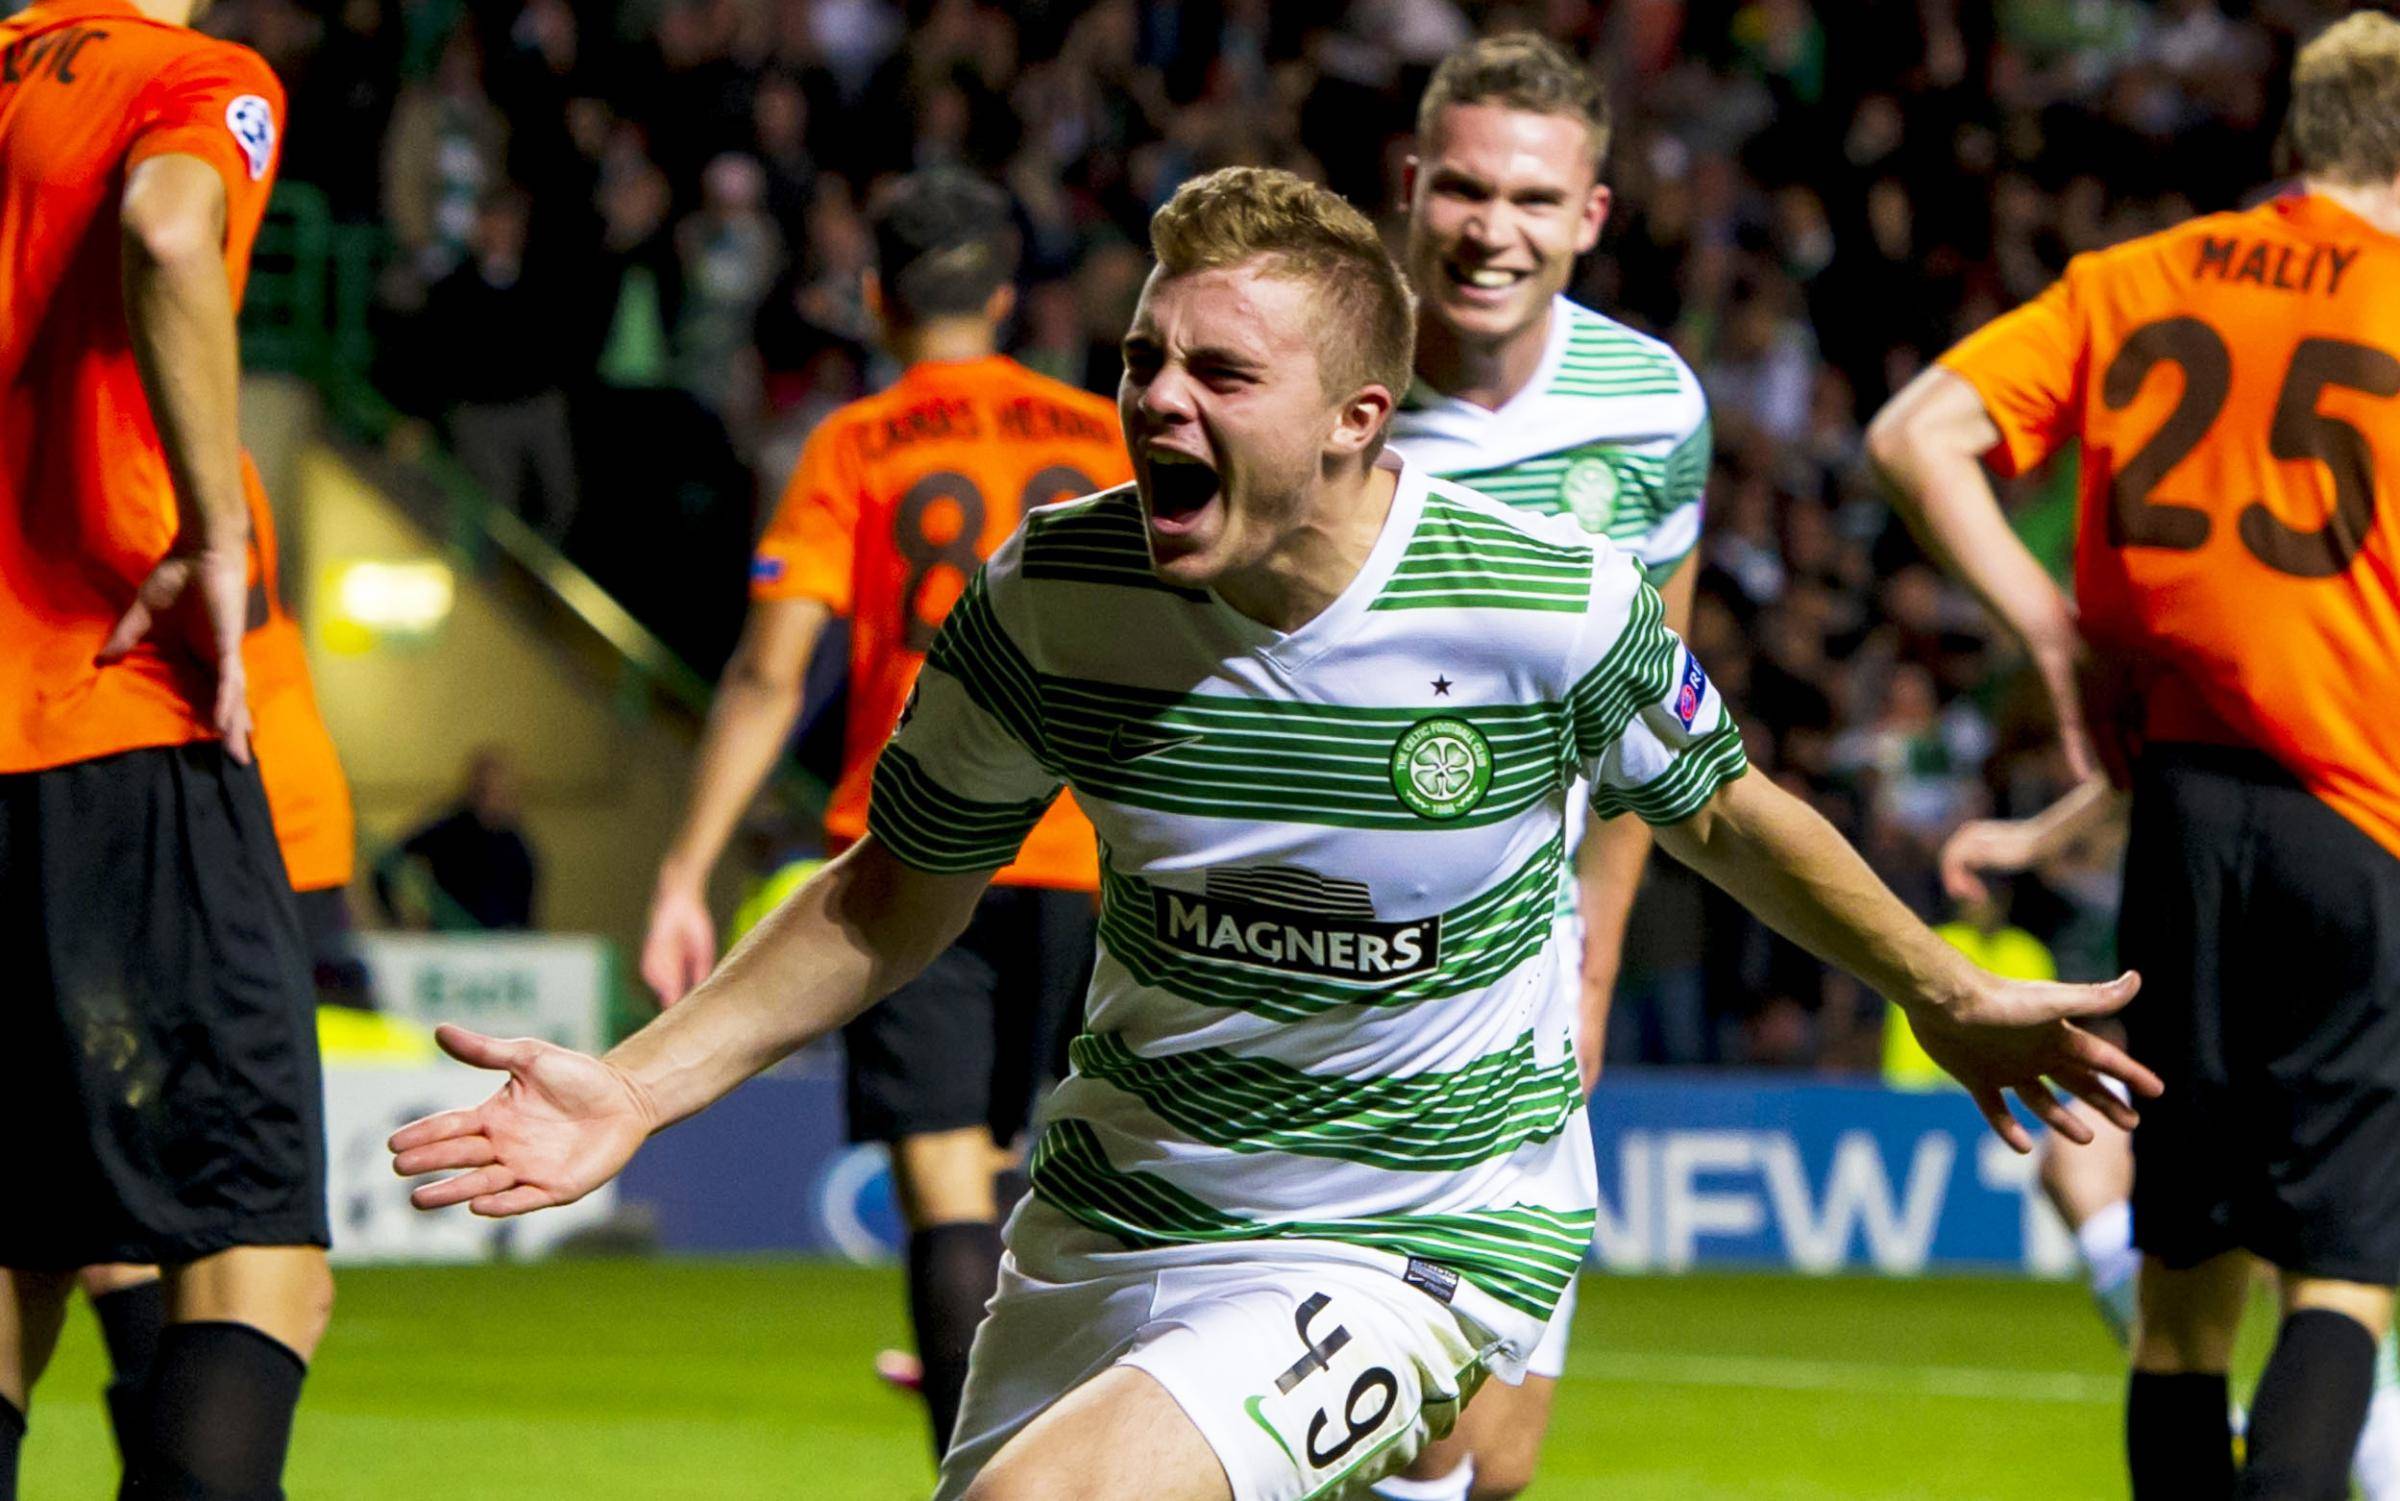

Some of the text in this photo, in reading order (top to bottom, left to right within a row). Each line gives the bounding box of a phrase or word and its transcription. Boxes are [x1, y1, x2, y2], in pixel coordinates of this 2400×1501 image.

[2194, 236, 2358, 294] MALIY
[2103, 315, 2400, 578] 25
[1402, 725, 1431, 752] CELTIC
[1168, 894, 1423, 973] MAGNERS
[1274, 1291, 1399, 1470] 49
